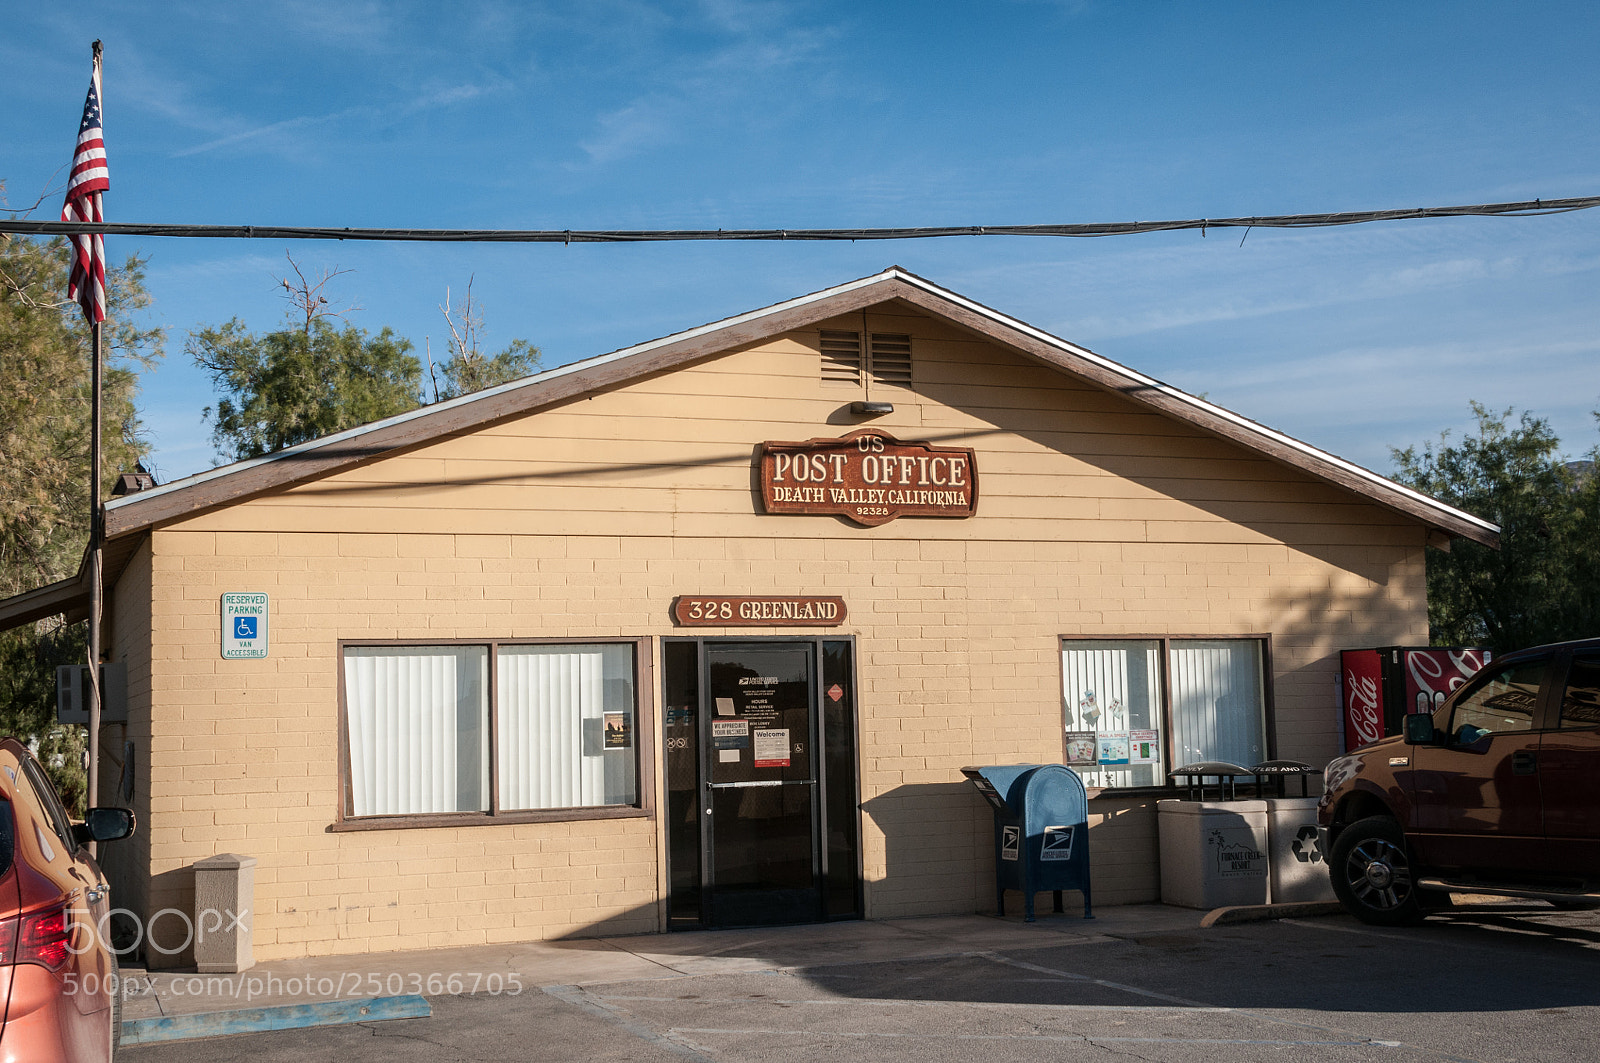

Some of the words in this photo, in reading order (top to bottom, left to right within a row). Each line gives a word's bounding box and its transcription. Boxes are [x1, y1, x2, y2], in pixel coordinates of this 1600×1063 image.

[856, 436, 885, 453] US
[773, 453, 848, 483] POST
[862, 455, 966, 486] OFFICE
[773, 487, 825, 503] DEATH
[857, 507, 889, 516] 92328
[226, 595, 265, 604] RESERVED
[228, 606, 262, 614] PARKING
[689, 601, 733, 620] 328
[739, 601, 838, 620] GREENLAND
